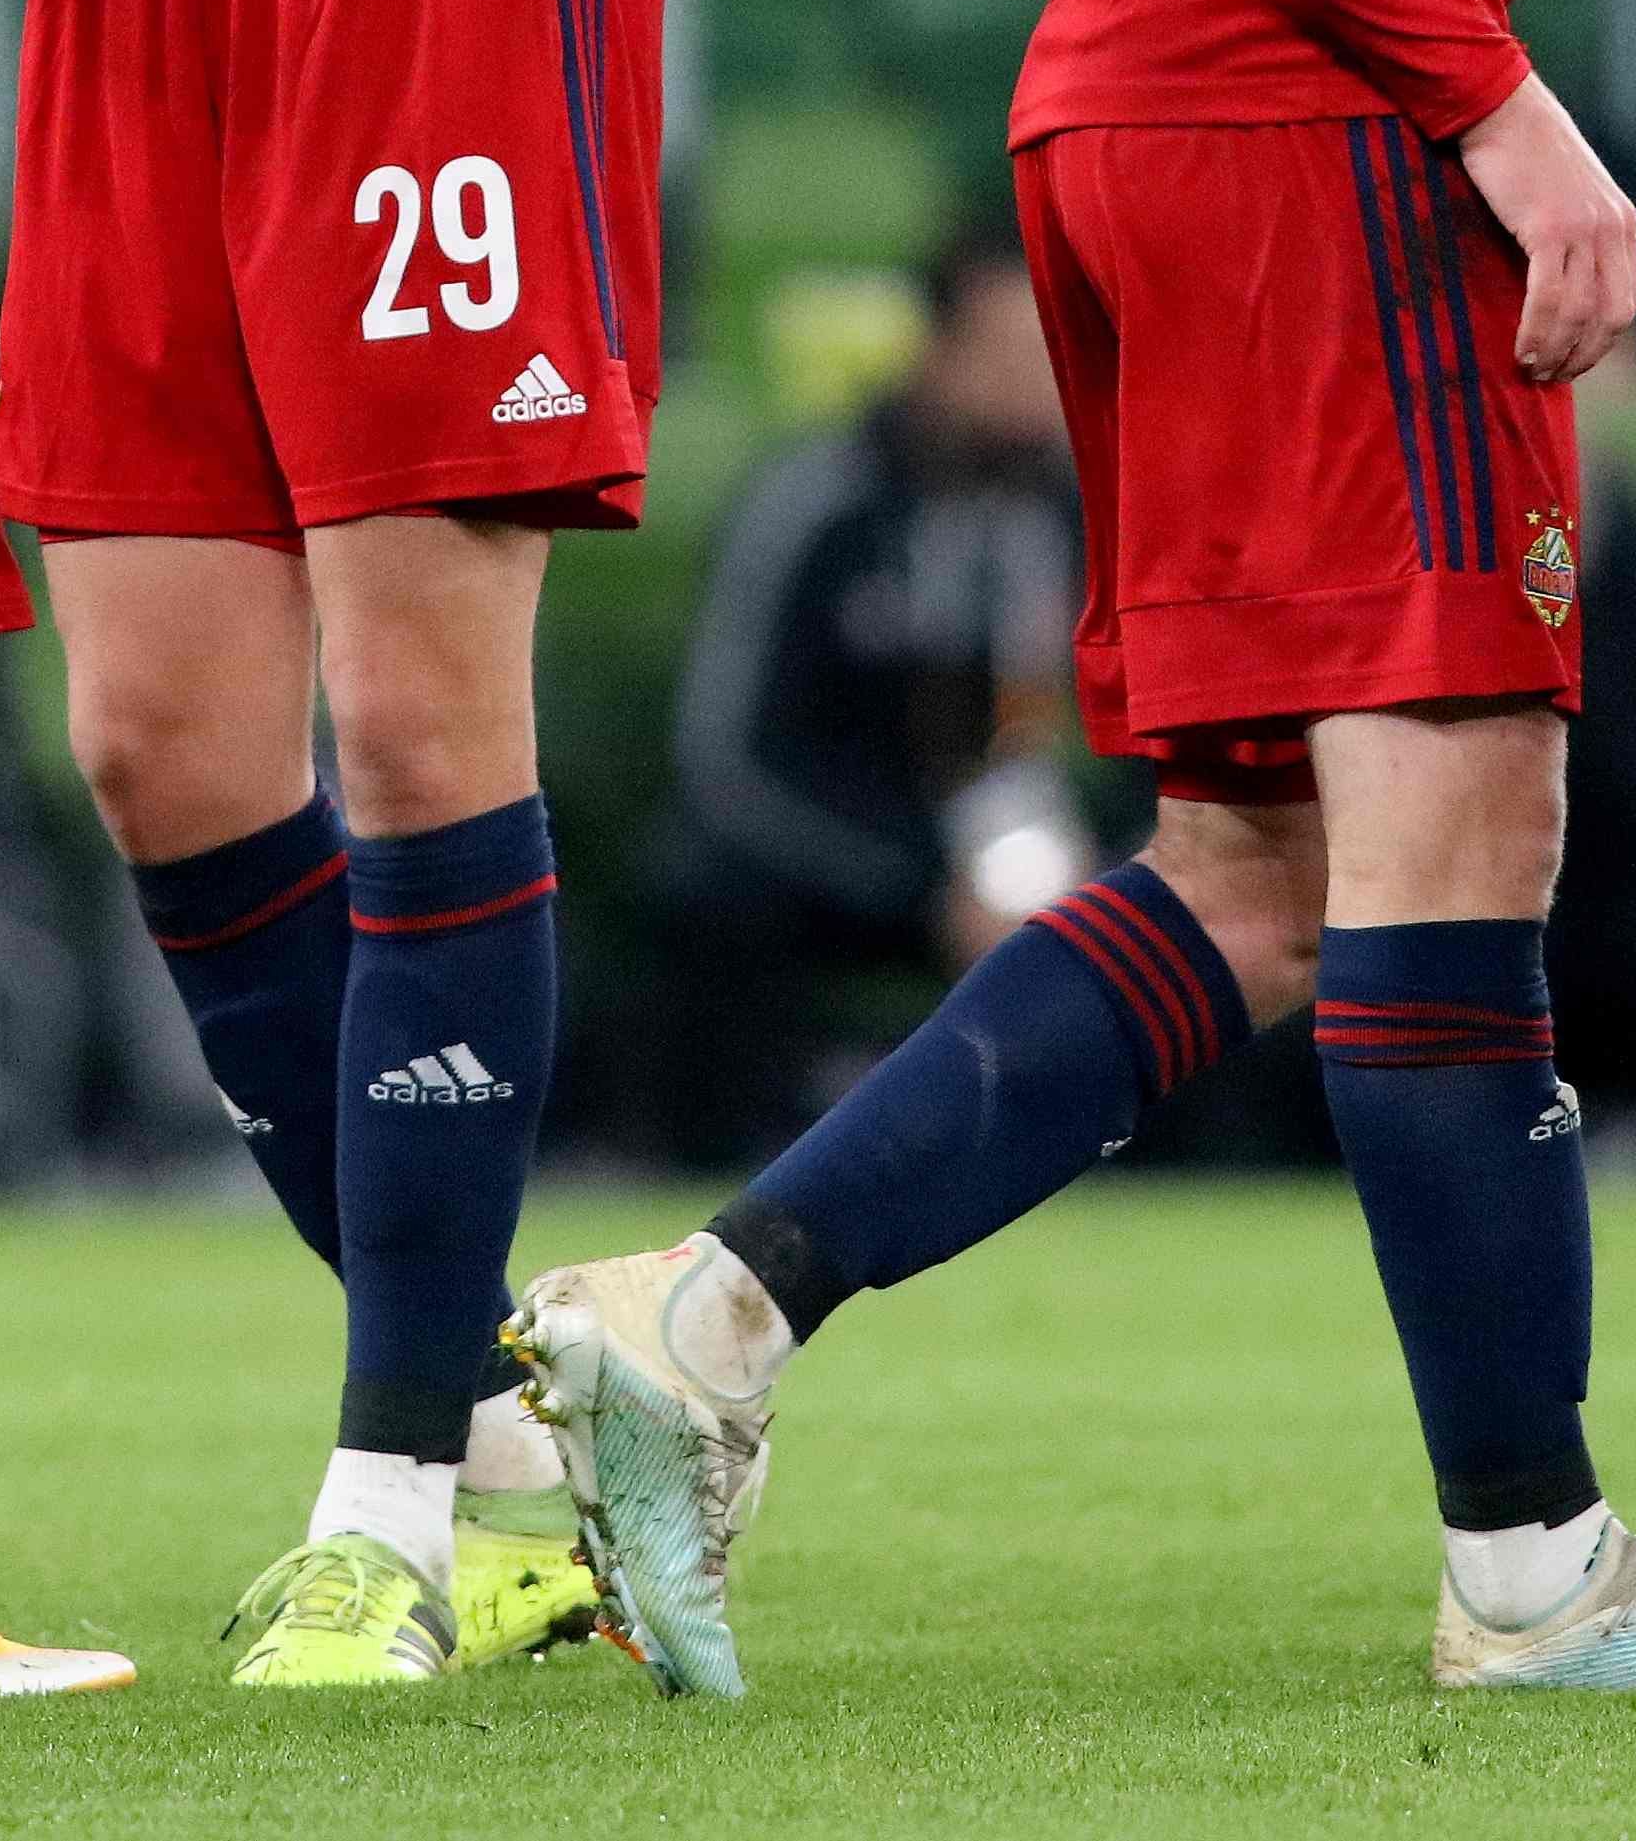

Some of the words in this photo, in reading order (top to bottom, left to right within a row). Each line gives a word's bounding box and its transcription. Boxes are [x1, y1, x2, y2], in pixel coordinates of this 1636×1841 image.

[354, 155, 519, 341] 29
[492, 393, 587, 423] adidas
[368, 1082, 514, 1103] adidas
